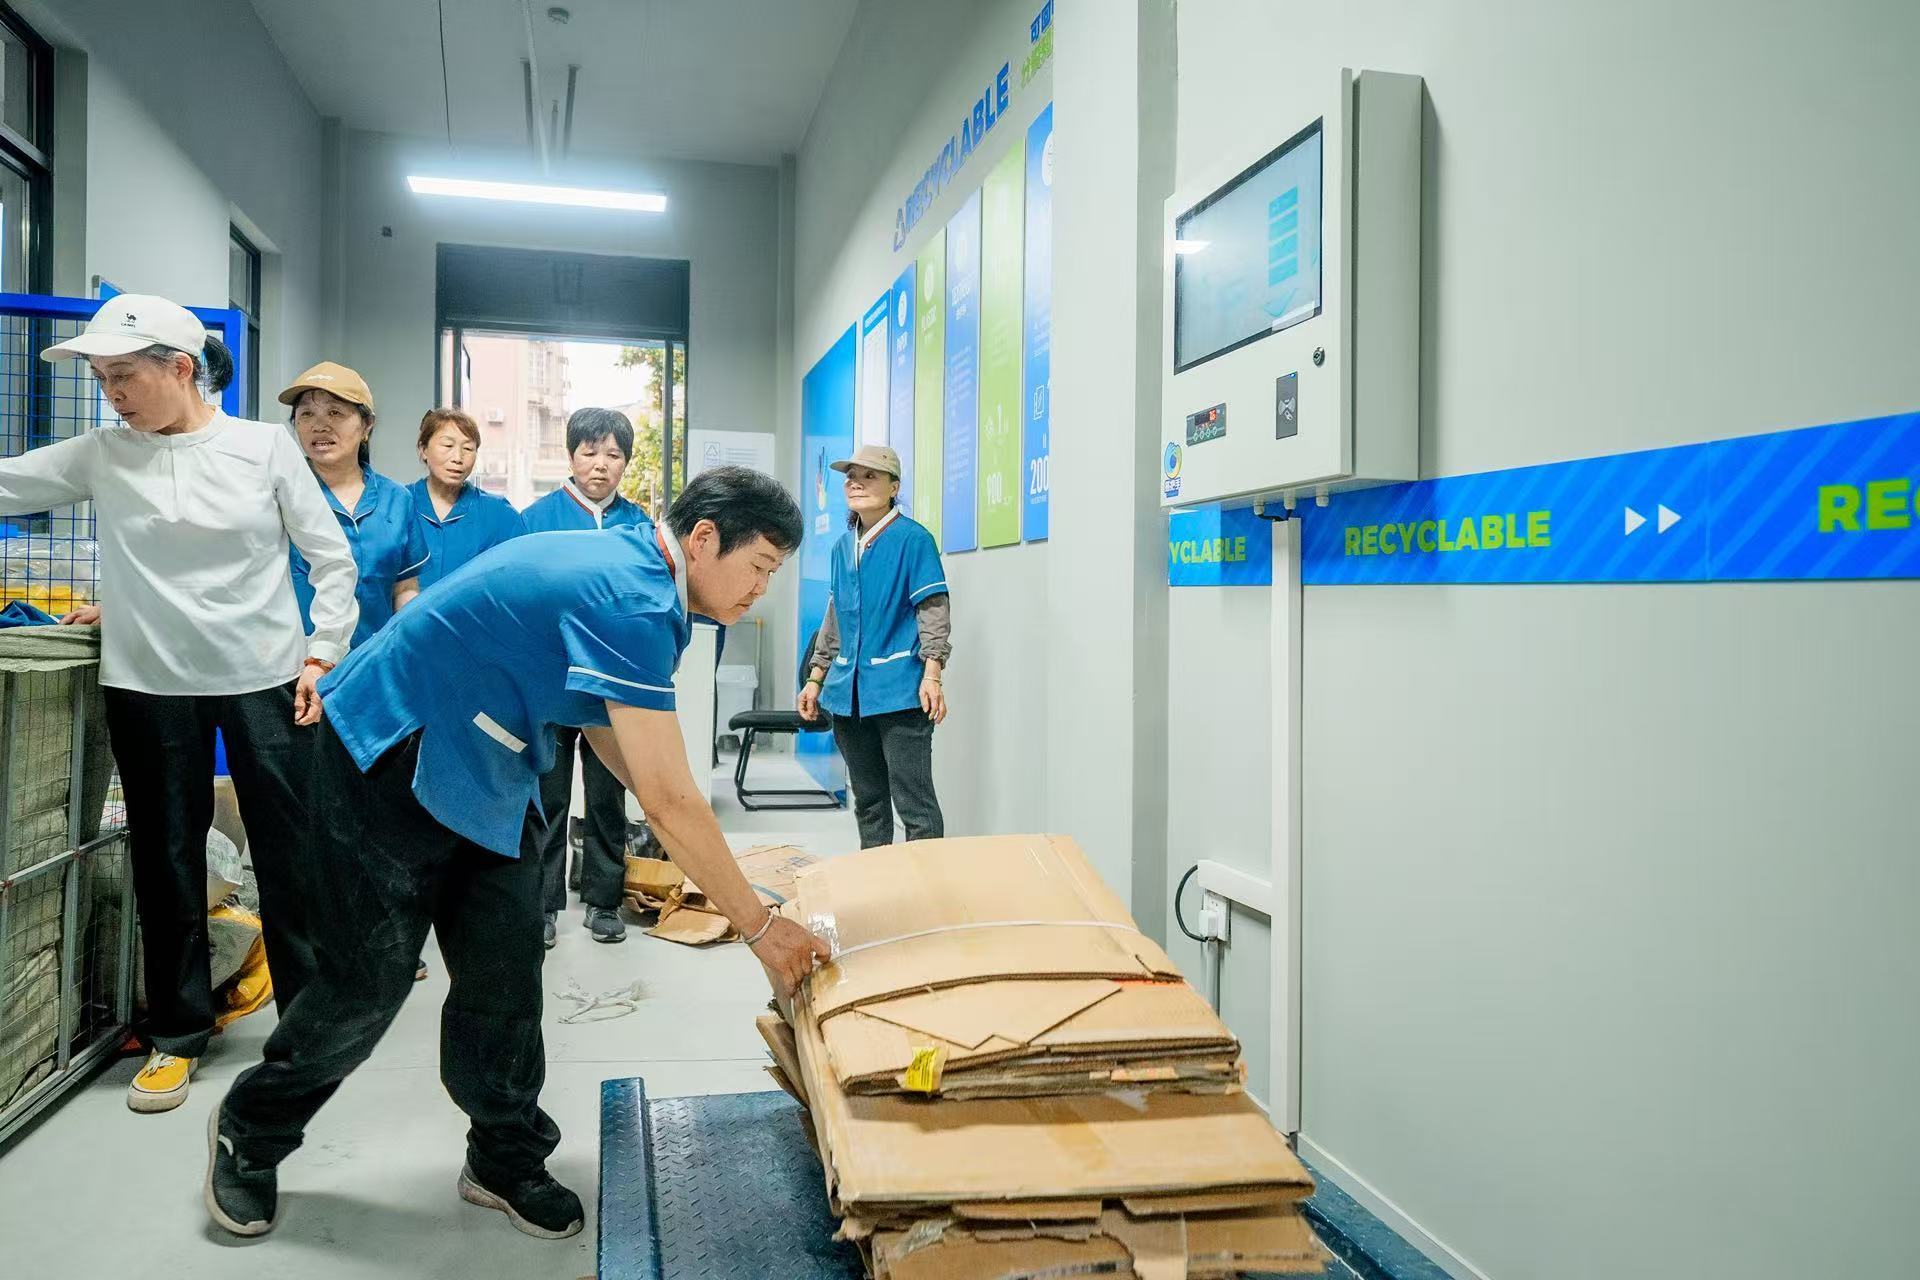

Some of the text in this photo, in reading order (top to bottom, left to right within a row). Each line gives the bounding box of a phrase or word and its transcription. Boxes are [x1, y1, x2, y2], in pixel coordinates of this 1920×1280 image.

[1031, 0, 1054, 43] 可回
[905, 61, 1009, 233] RECYCLABLE
[1818, 477, 1920, 533] RE
[1168, 536, 1247, 564] YCLABLE
[1344, 511, 1551, 556] RECYCLABLE
